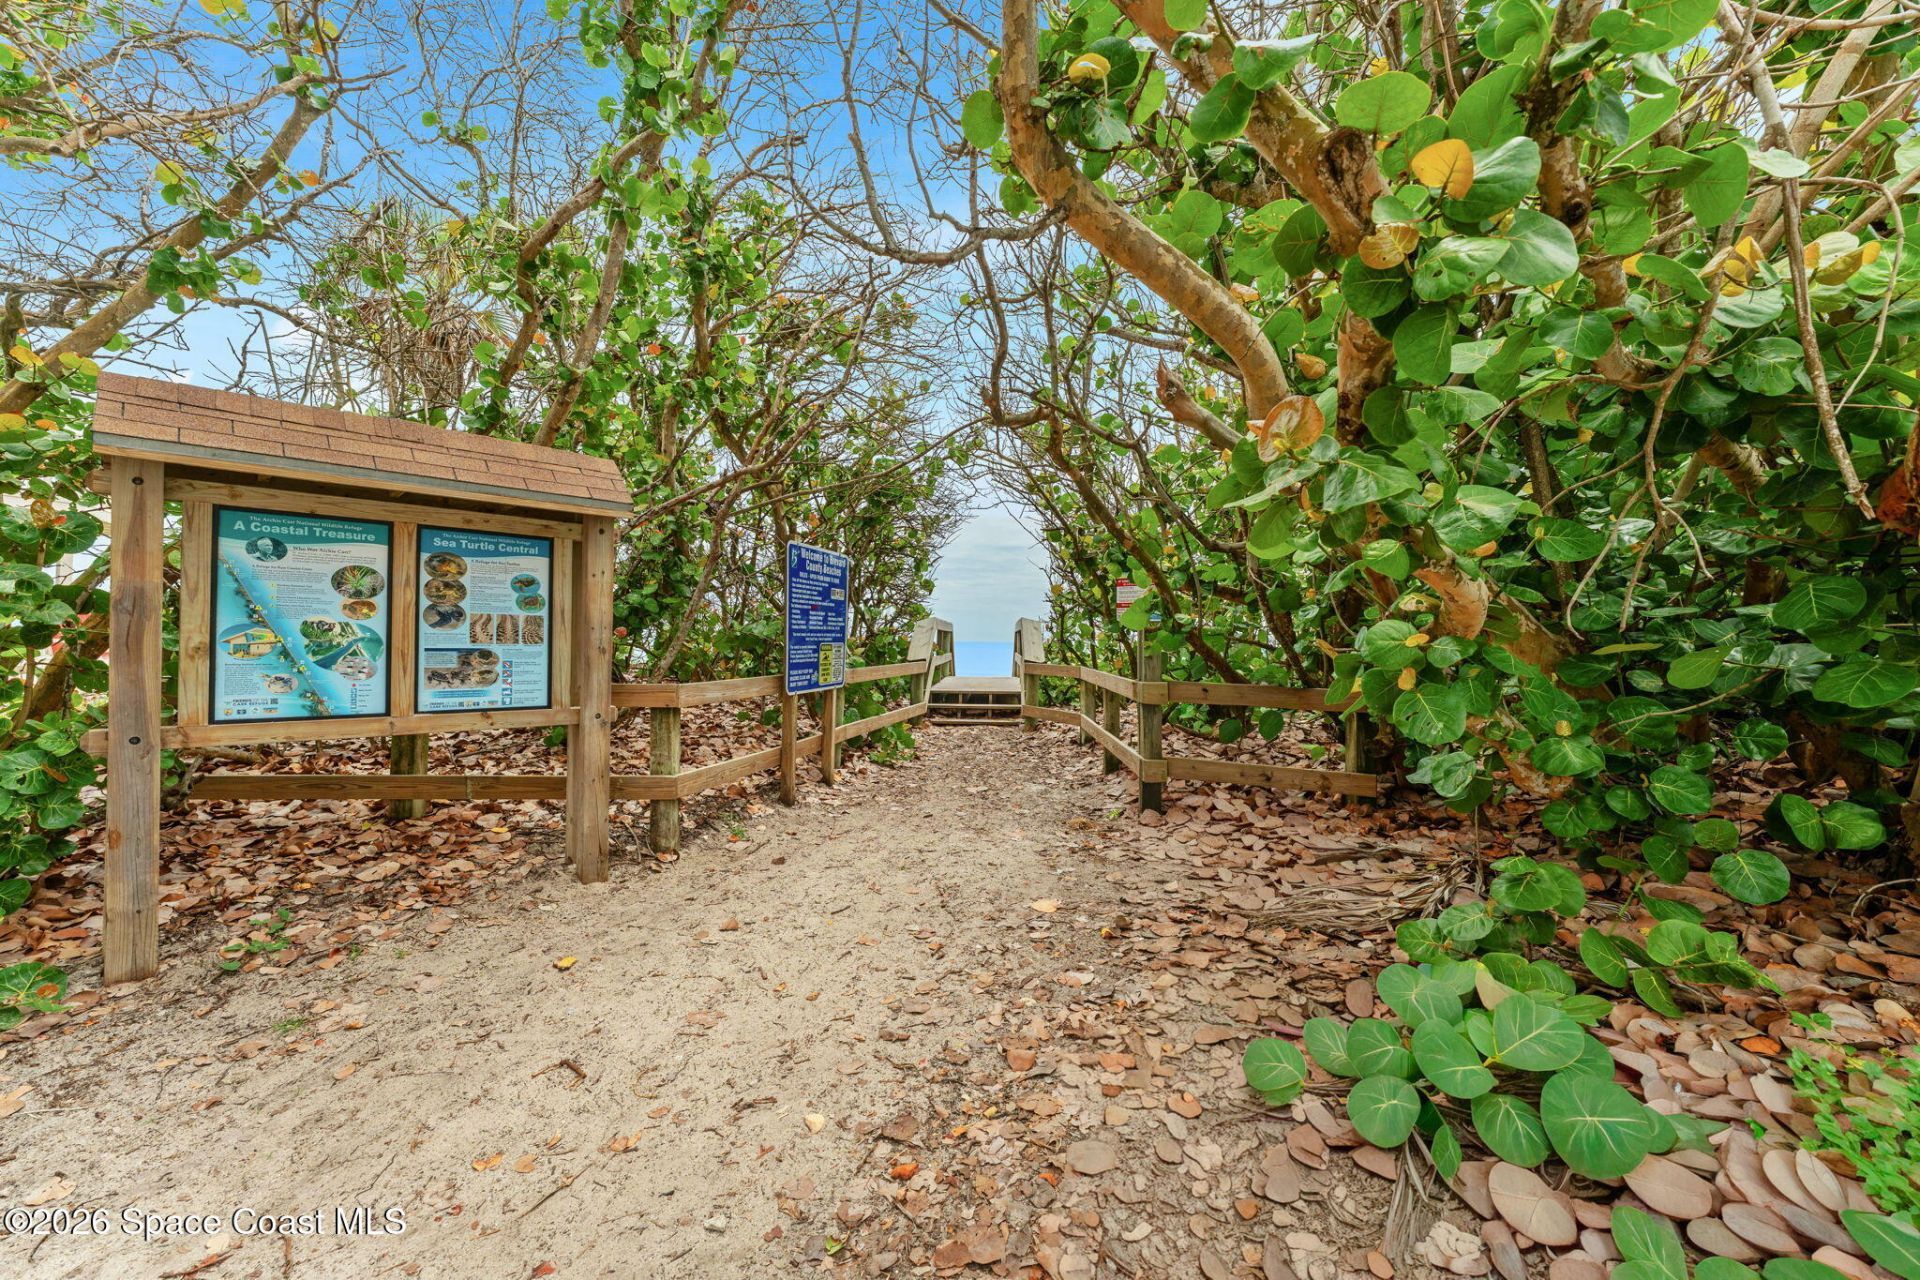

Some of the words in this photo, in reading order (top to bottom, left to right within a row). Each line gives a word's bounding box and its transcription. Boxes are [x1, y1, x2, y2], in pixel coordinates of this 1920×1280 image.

[233, 520, 245, 531] A
[250, 521, 309, 536] Coastal
[313, 527, 376, 542] Treasure
[433, 537, 457, 548] Sea
[460, 540, 495, 551] Turtle
[498, 543, 539, 555] Central
[801, 548, 823, 562] Welcome
[824, 554, 829, 564] to
[806, 560, 823, 575] County
[823, 564, 841, 577] Beaches
